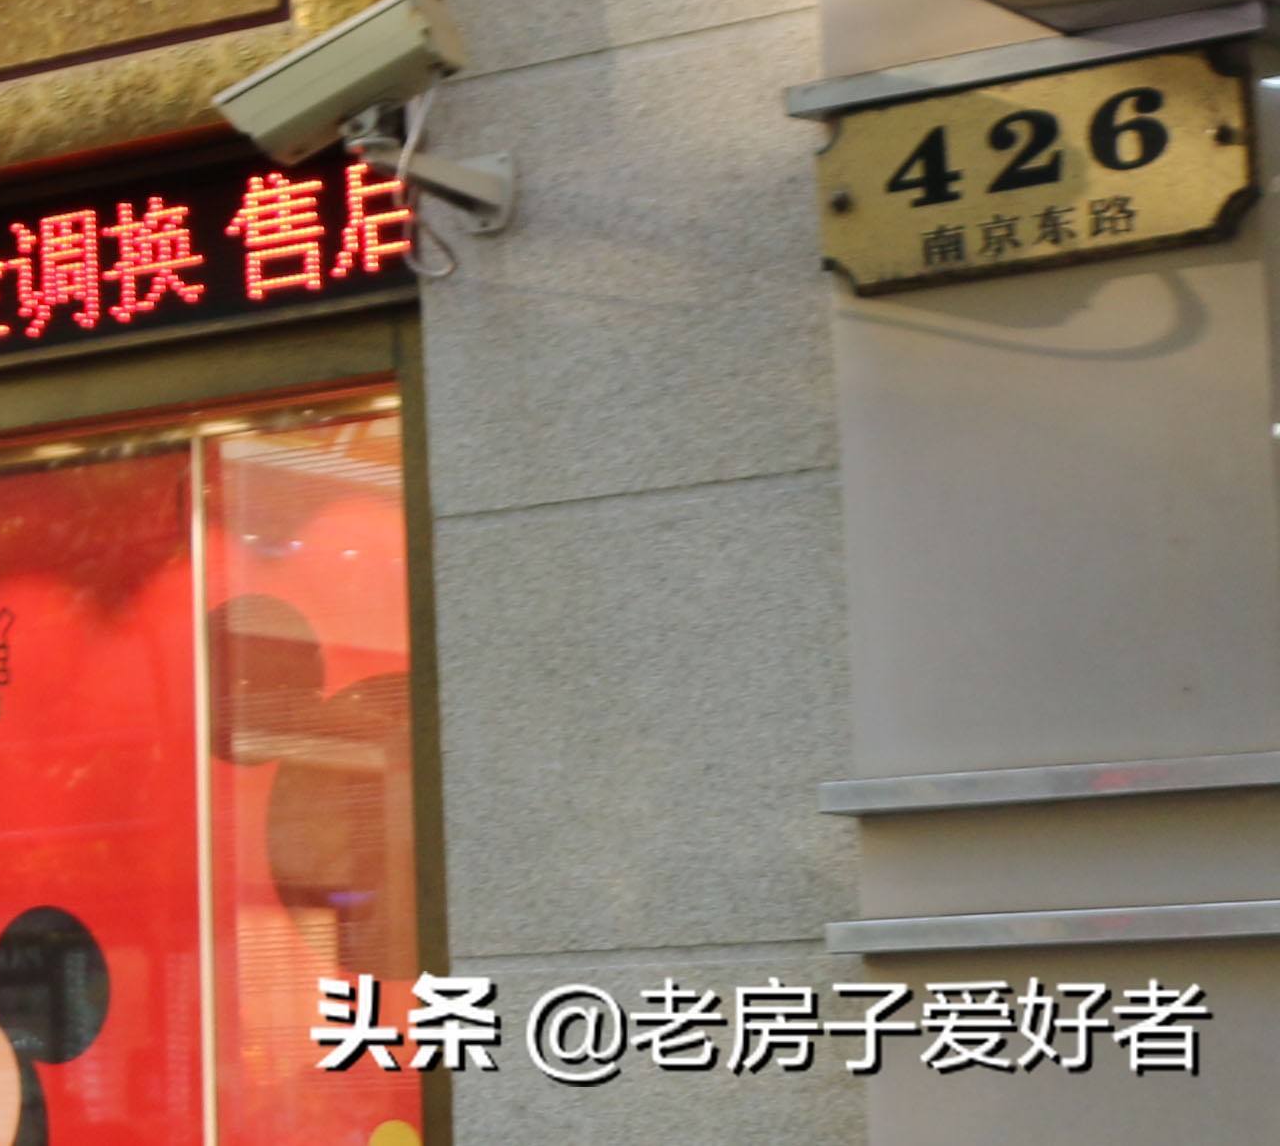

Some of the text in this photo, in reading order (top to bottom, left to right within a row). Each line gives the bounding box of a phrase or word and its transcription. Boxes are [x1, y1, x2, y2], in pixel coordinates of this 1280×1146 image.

[886, 86, 1170, 208] 426
[920, 194, 1138, 268] 南京东路
